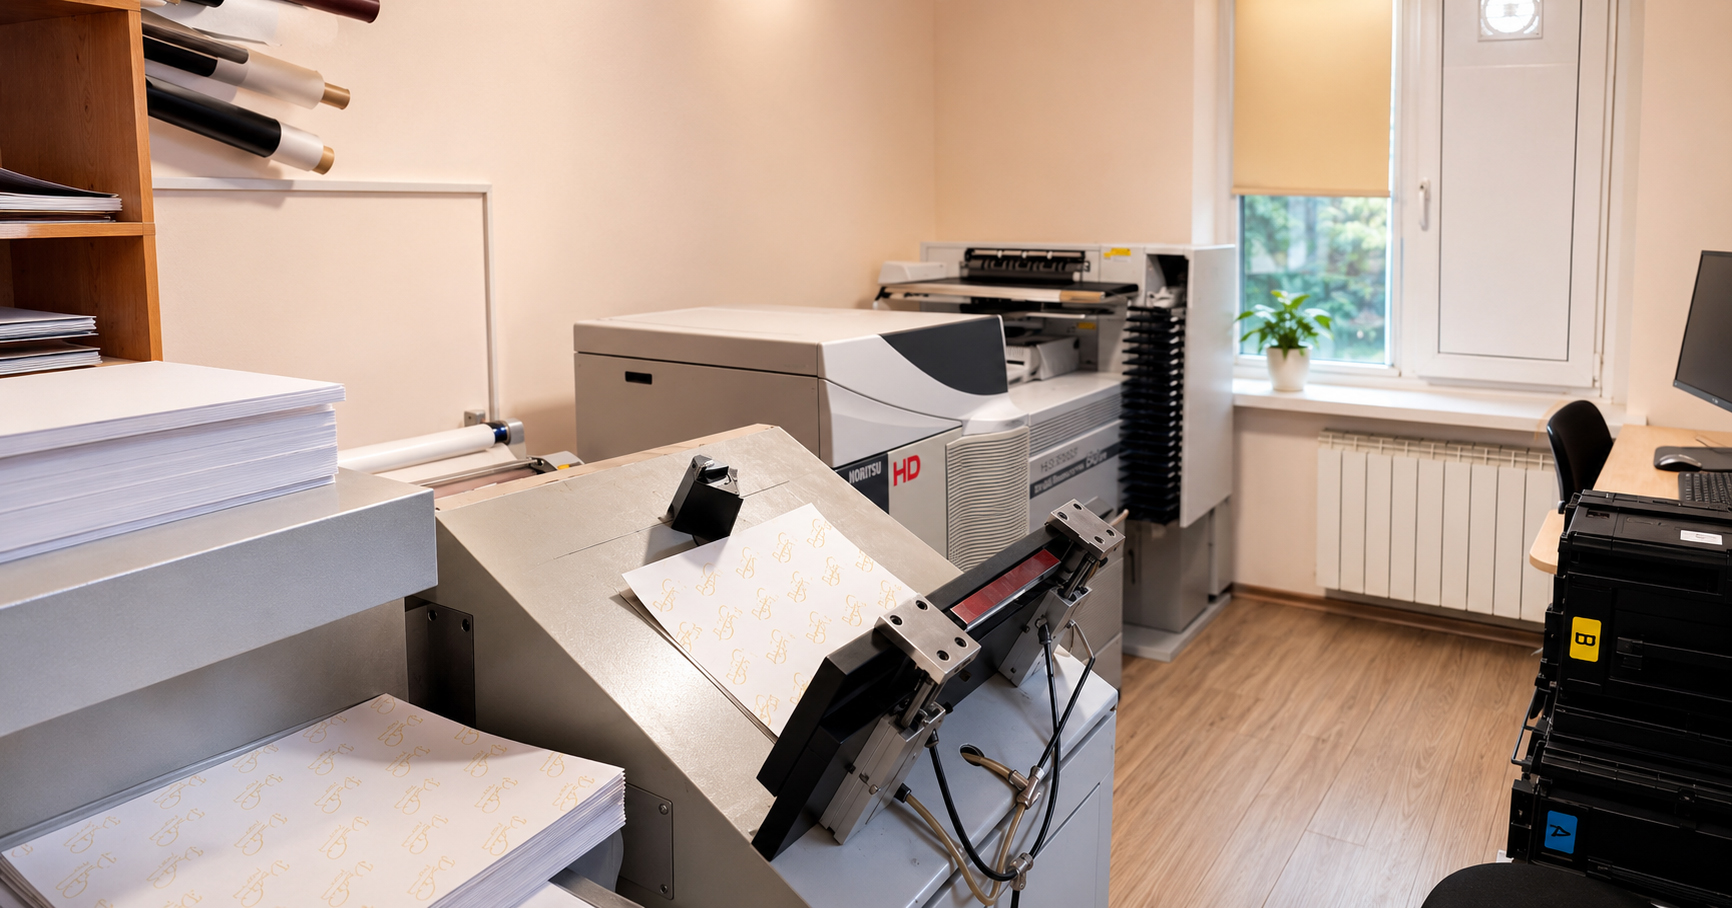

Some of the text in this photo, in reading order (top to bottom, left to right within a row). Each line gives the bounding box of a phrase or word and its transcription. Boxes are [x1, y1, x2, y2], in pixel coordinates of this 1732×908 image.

[849, 461, 882, 484] NORITSU
[893, 455, 921, 487] HD
[1575, 632, 1596, 647] B
[1550, 824, 1571, 837] A
